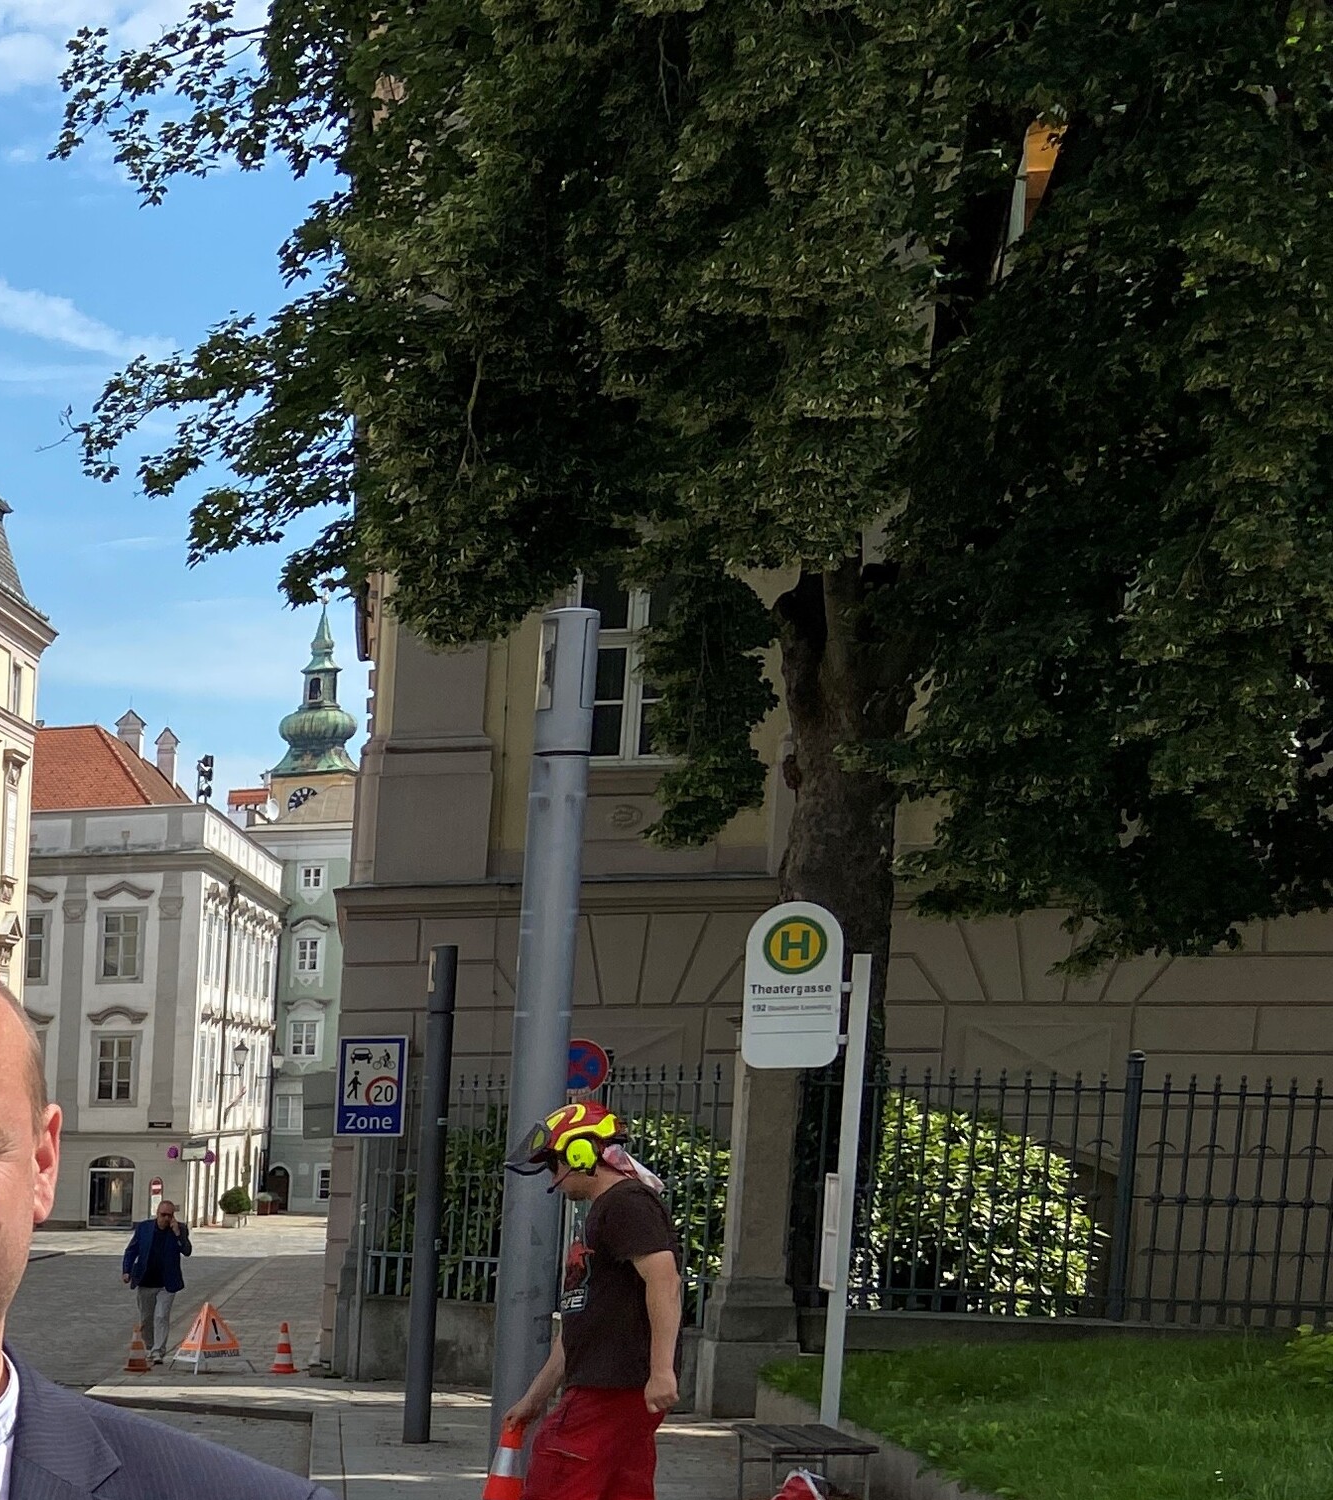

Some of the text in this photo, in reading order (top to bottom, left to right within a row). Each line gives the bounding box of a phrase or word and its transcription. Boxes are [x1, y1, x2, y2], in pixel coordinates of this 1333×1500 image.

[750, 984, 832, 995] Theatergasse
[373, 1085, 394, 1102] 20
[344, 1112, 392, 1129] Zone
